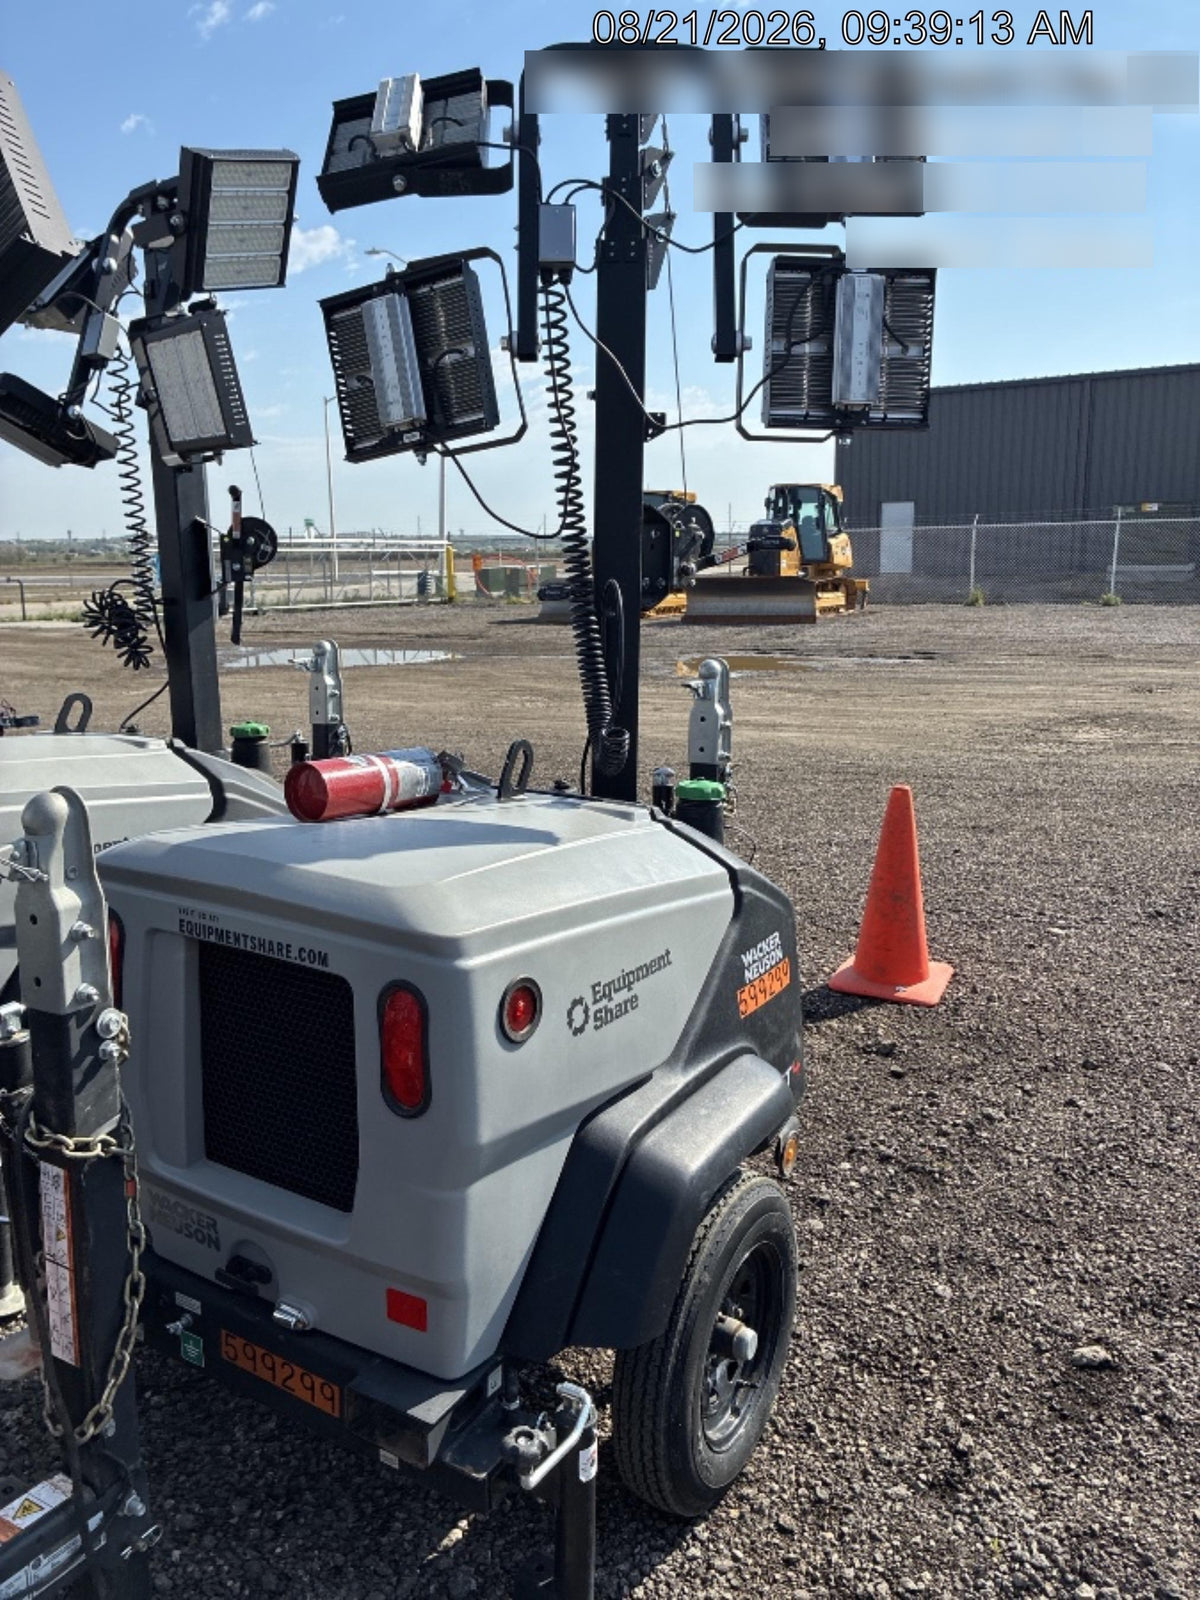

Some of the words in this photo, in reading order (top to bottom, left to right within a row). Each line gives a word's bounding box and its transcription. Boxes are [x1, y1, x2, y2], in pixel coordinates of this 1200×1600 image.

[178, 918, 329, 968] EQUIPMENTSHARE.COM
[740, 931, 782, 967] WACKER
[744, 946, 784, 984] NEUSON
[591, 948, 672, 1006] Equipment
[593, 993, 639, 1031] Share
[223, 1332, 336, 1414] 599299
